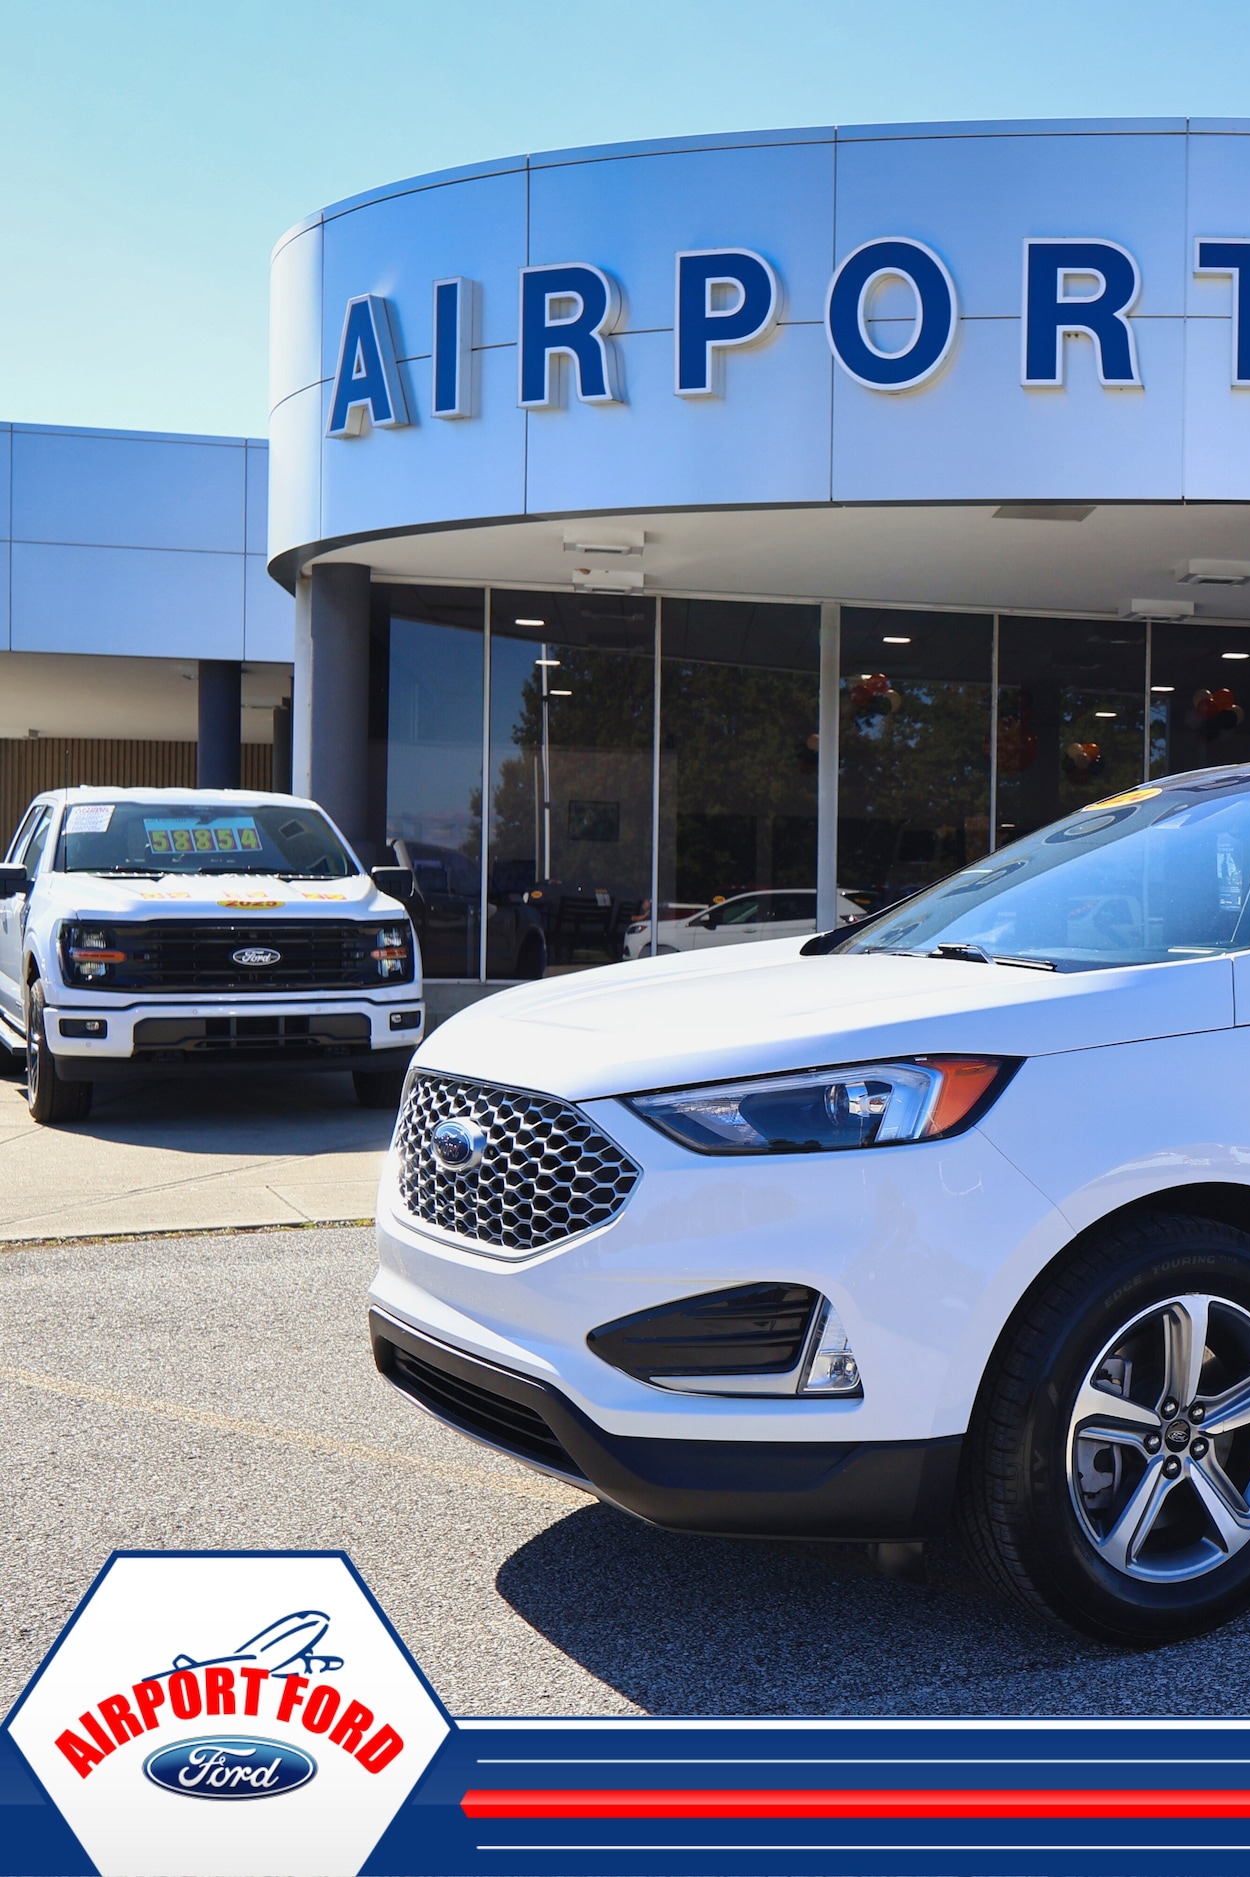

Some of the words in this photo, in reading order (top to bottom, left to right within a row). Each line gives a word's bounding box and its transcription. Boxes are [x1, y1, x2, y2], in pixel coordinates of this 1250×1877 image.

[152, 829, 257, 851] 58854
[242, 950, 271, 963] Ford
[1103, 1274, 1142, 1309] EDGE
[1151, 1255, 1216, 1275] TOURING
